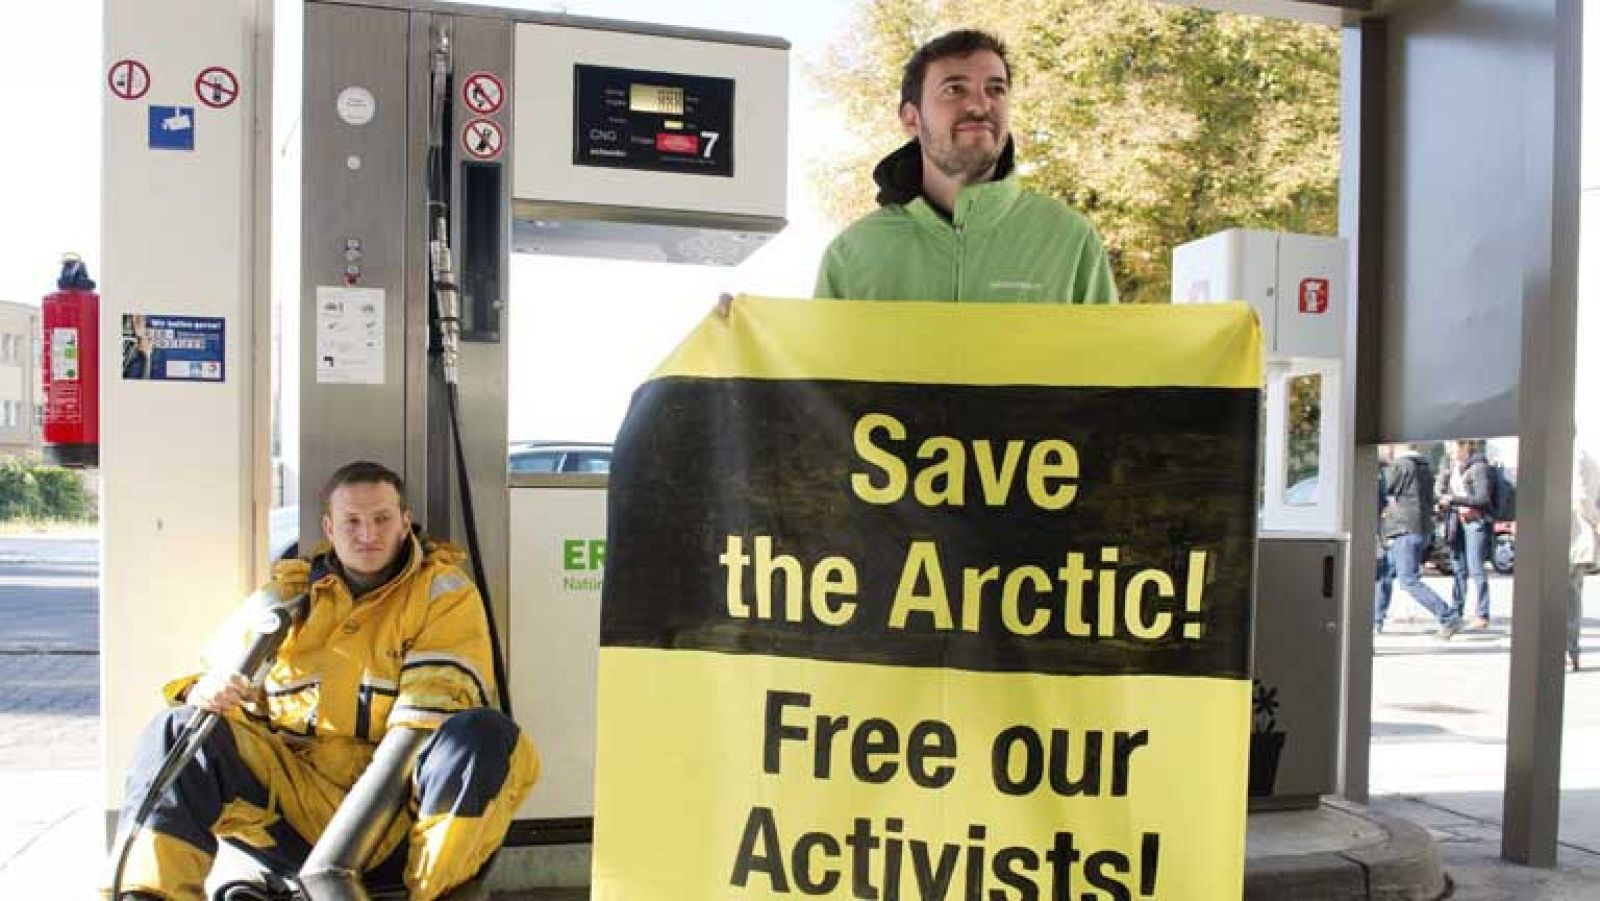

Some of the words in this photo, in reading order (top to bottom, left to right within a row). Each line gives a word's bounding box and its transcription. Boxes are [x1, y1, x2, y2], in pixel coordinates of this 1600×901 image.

[700, 131, 719, 158] 7
[851, 412, 1080, 511] Save
[719, 535, 858, 626] the
[888, 540, 1207, 640] Arctic!
[763, 689, 958, 788] Free
[991, 725, 1149, 797] our
[729, 806, 1160, 901] Activists!
